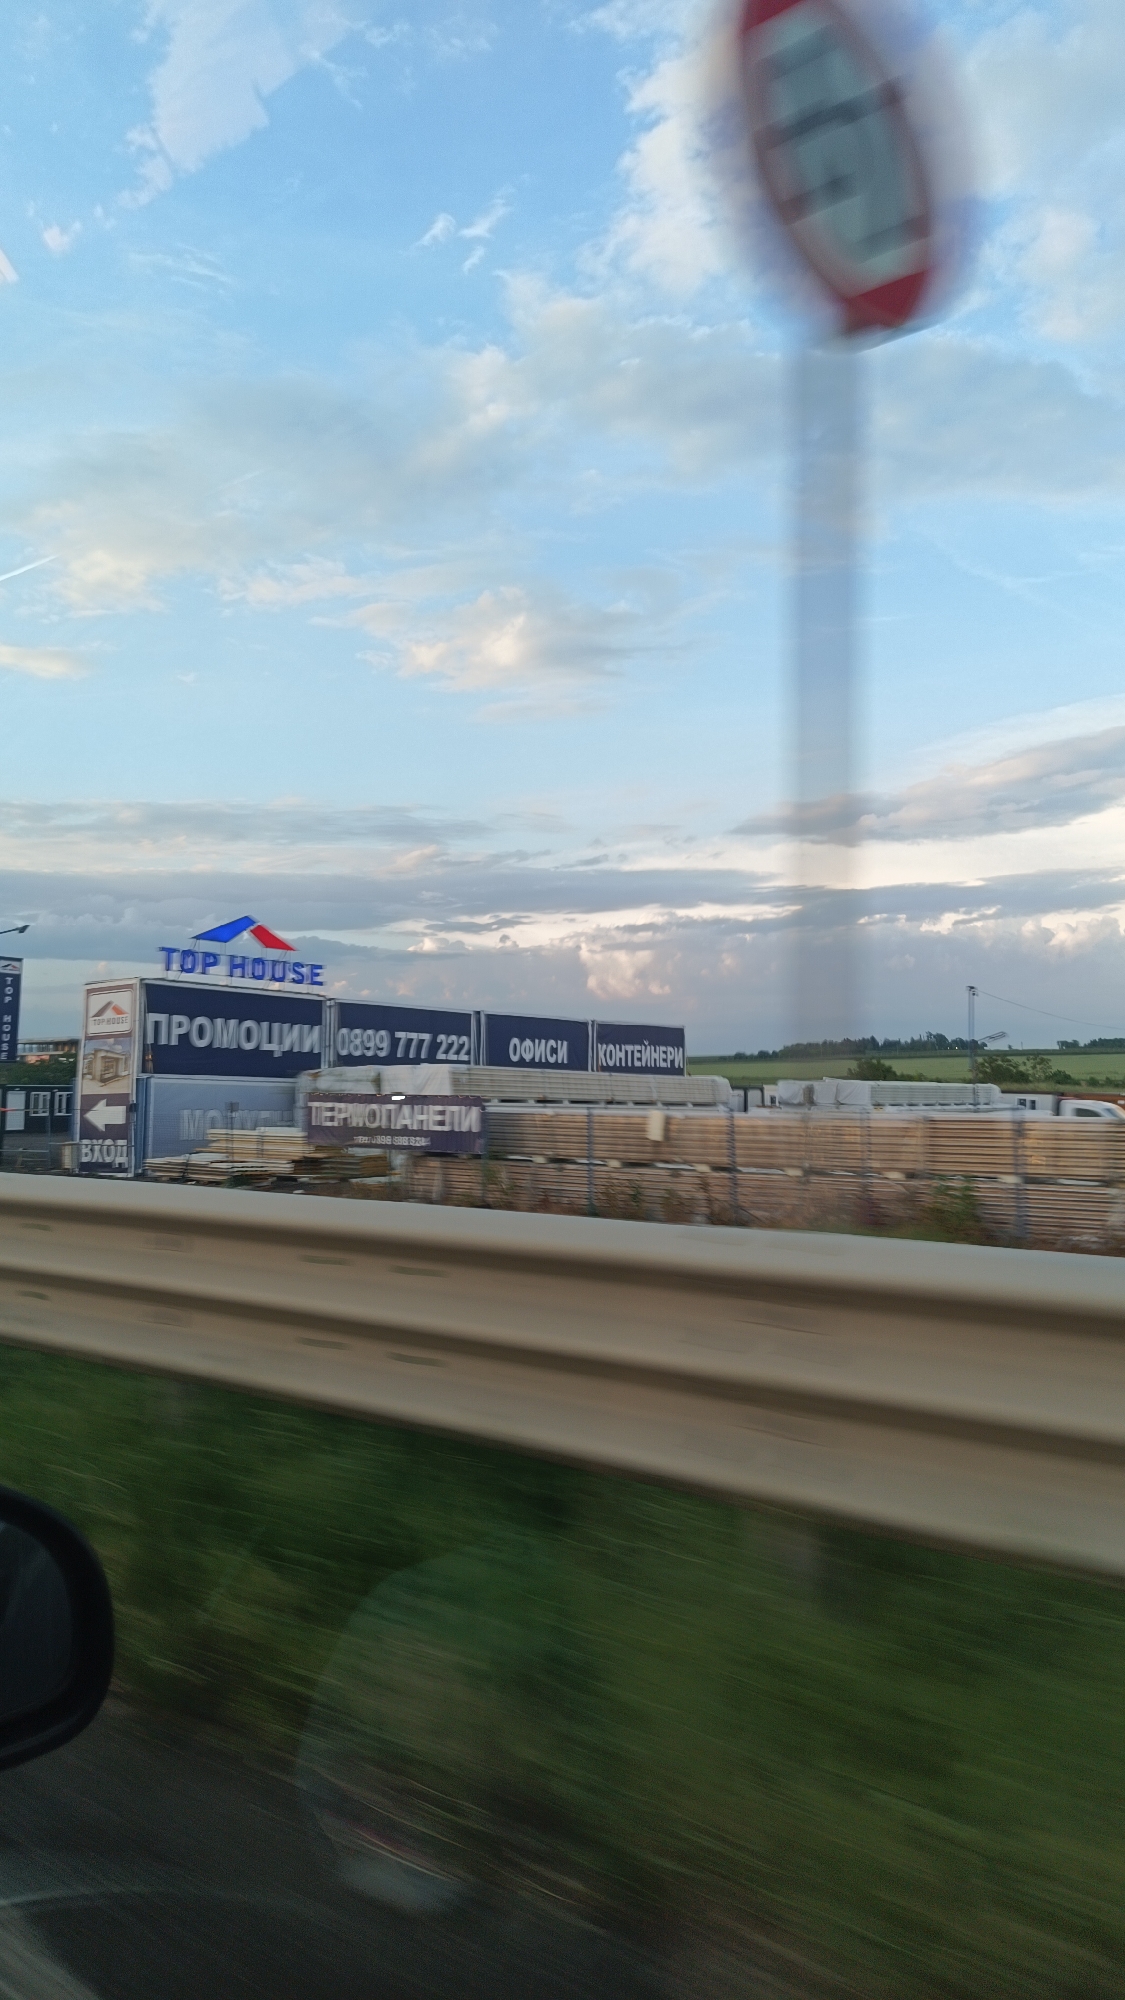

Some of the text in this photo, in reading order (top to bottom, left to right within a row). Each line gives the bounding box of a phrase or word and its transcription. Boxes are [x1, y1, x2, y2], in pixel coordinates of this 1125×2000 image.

[159, 947, 326, 986] TOP HOUSE
[3, 977, 14, 1003] TOP
[92, 1016, 129, 1026] TOP HOUSE
[146, 1012, 322, 1057] ПРОМОЦИИ
[336, 1027, 471, 1061] 0899 777 222
[508, 1037, 568, 1064] ОФИСИ
[597, 1039, 684, 1069] КОНТЕЙНЕРИ
[308, 1101, 481, 1133] ТЕРМОПАНЕЛИ
[80, 1138, 129, 1168] ВХОД
